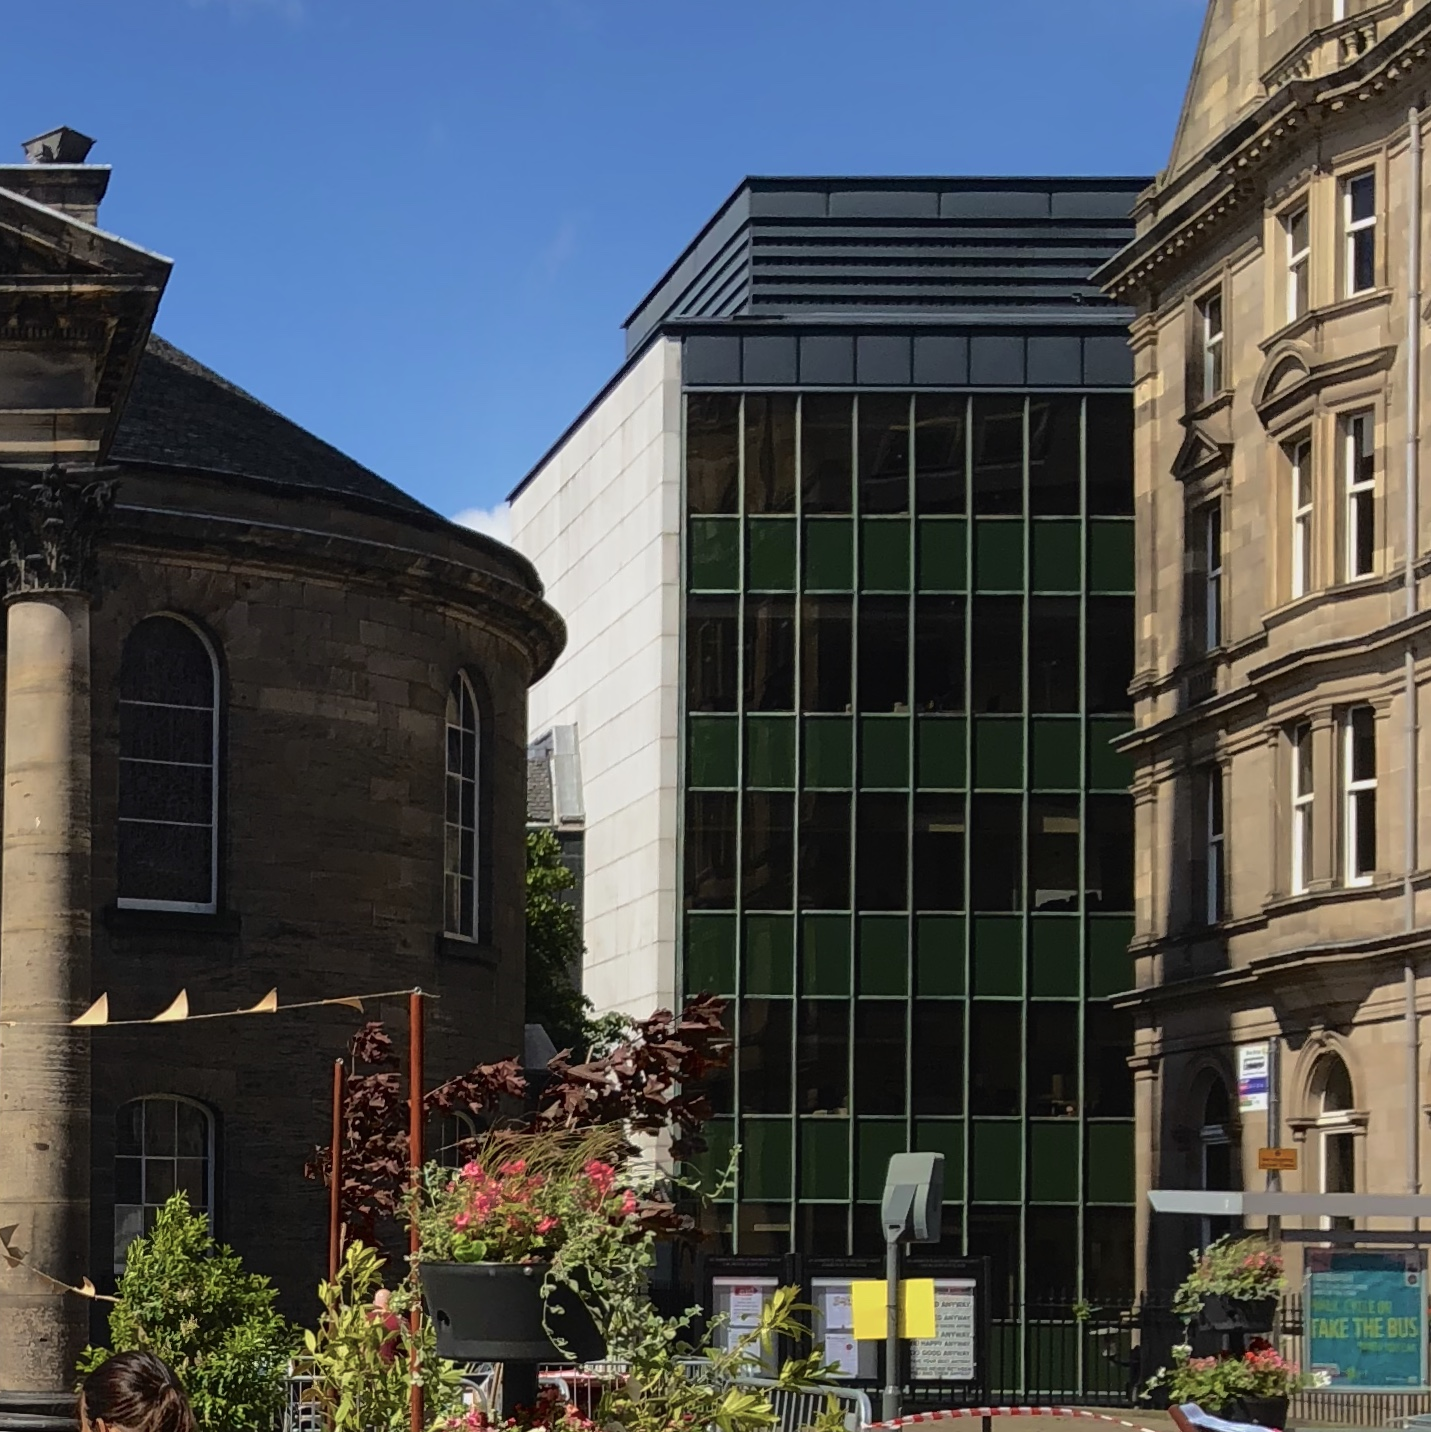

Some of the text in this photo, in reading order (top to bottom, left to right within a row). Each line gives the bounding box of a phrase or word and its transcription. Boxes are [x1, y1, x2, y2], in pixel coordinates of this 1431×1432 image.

[1312, 1316, 1419, 1338] TAKE THE BUS
